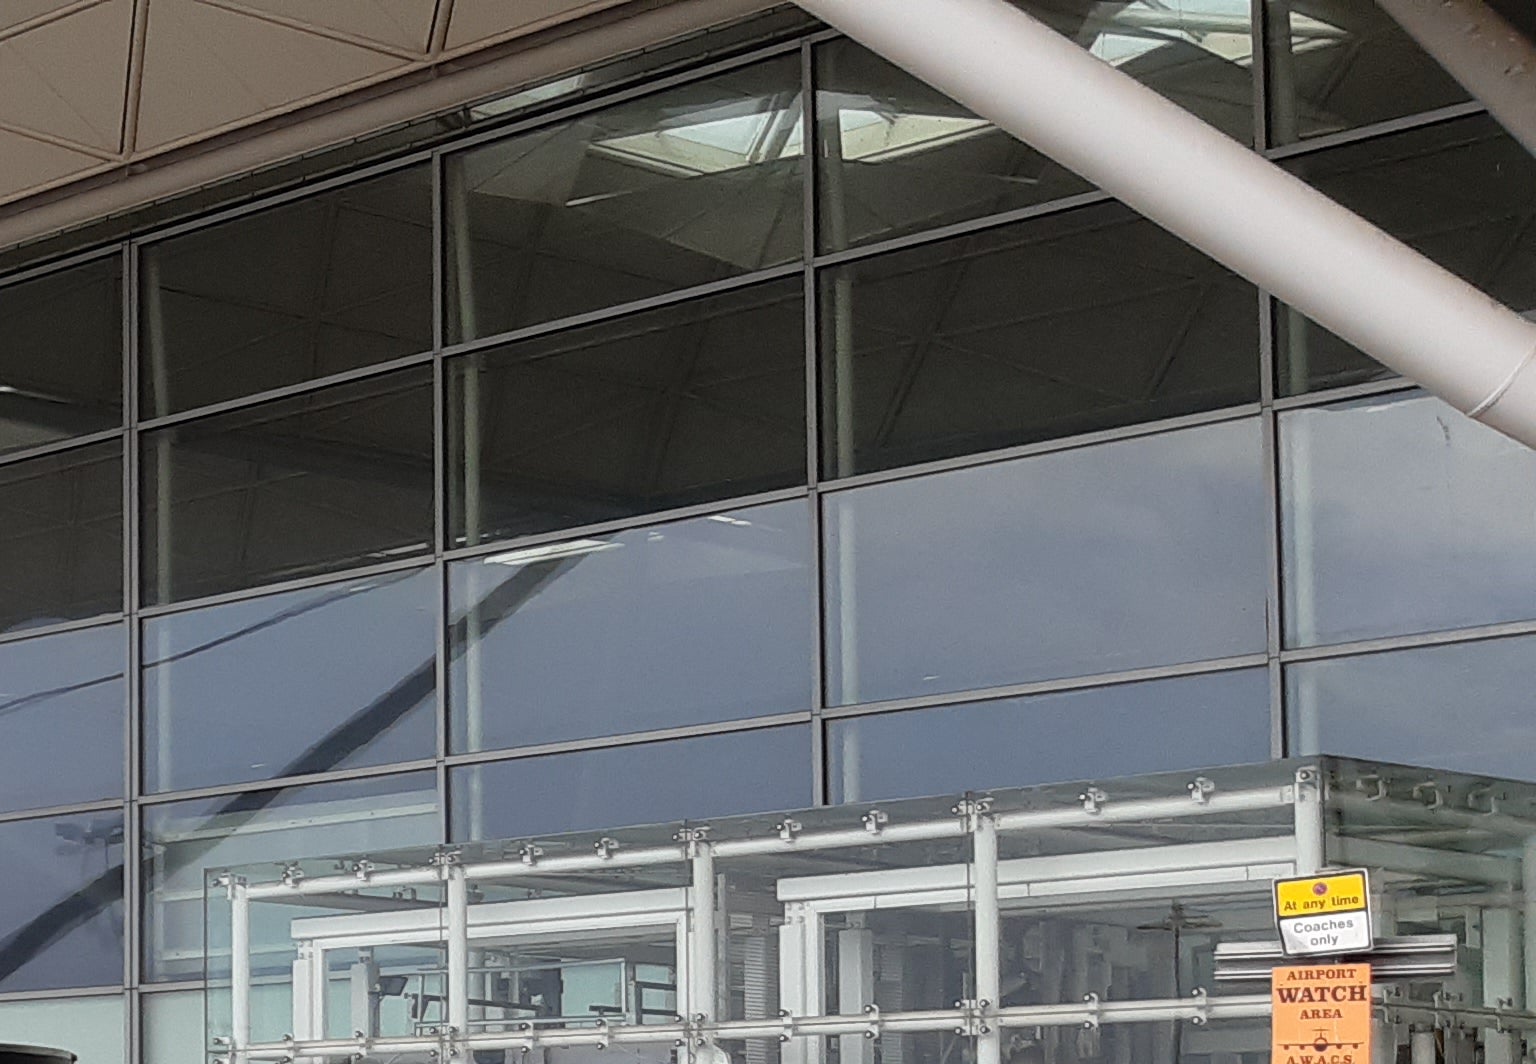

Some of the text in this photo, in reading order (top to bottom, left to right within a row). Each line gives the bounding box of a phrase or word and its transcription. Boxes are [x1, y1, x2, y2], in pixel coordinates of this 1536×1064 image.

[1284, 896, 1359, 911] At any time
[1294, 920, 1353, 933] Coaches
[1310, 934, 1338, 945] only
[1287, 969, 1356, 980] AIRPORT
[1276, 985, 1367, 1003] WATCH
[1300, 1009, 1343, 1019] AREA
